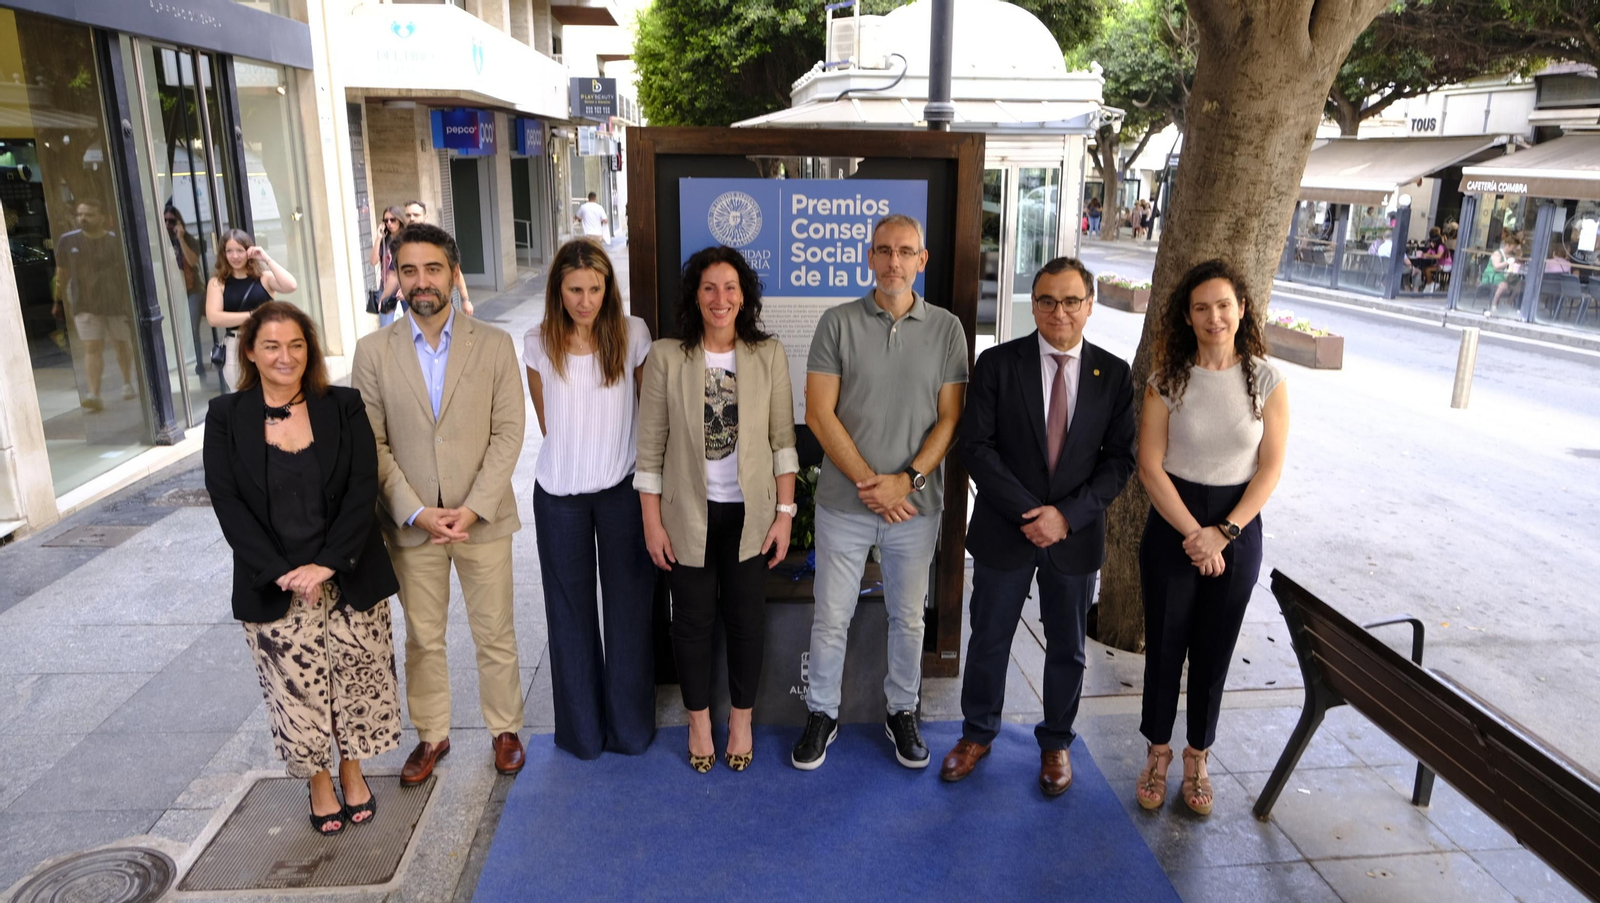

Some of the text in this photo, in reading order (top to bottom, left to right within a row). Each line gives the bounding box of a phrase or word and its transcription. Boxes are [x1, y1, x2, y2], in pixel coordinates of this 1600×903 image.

[446, 125, 475, 135] pepco
[1412, 118, 1436, 132] TOUS
[526, 128, 542, 149] pepco
[1466, 180, 1527, 193] CAFETERÍA COIMBRA
[792, 194, 889, 216] Premios
[791, 218, 872, 243] Consej
[741, 250, 771, 259] SIDAD
[791, 242, 862, 263] Social
[790, 266, 877, 287] de la U
[790, 686, 809, 694] ALM
